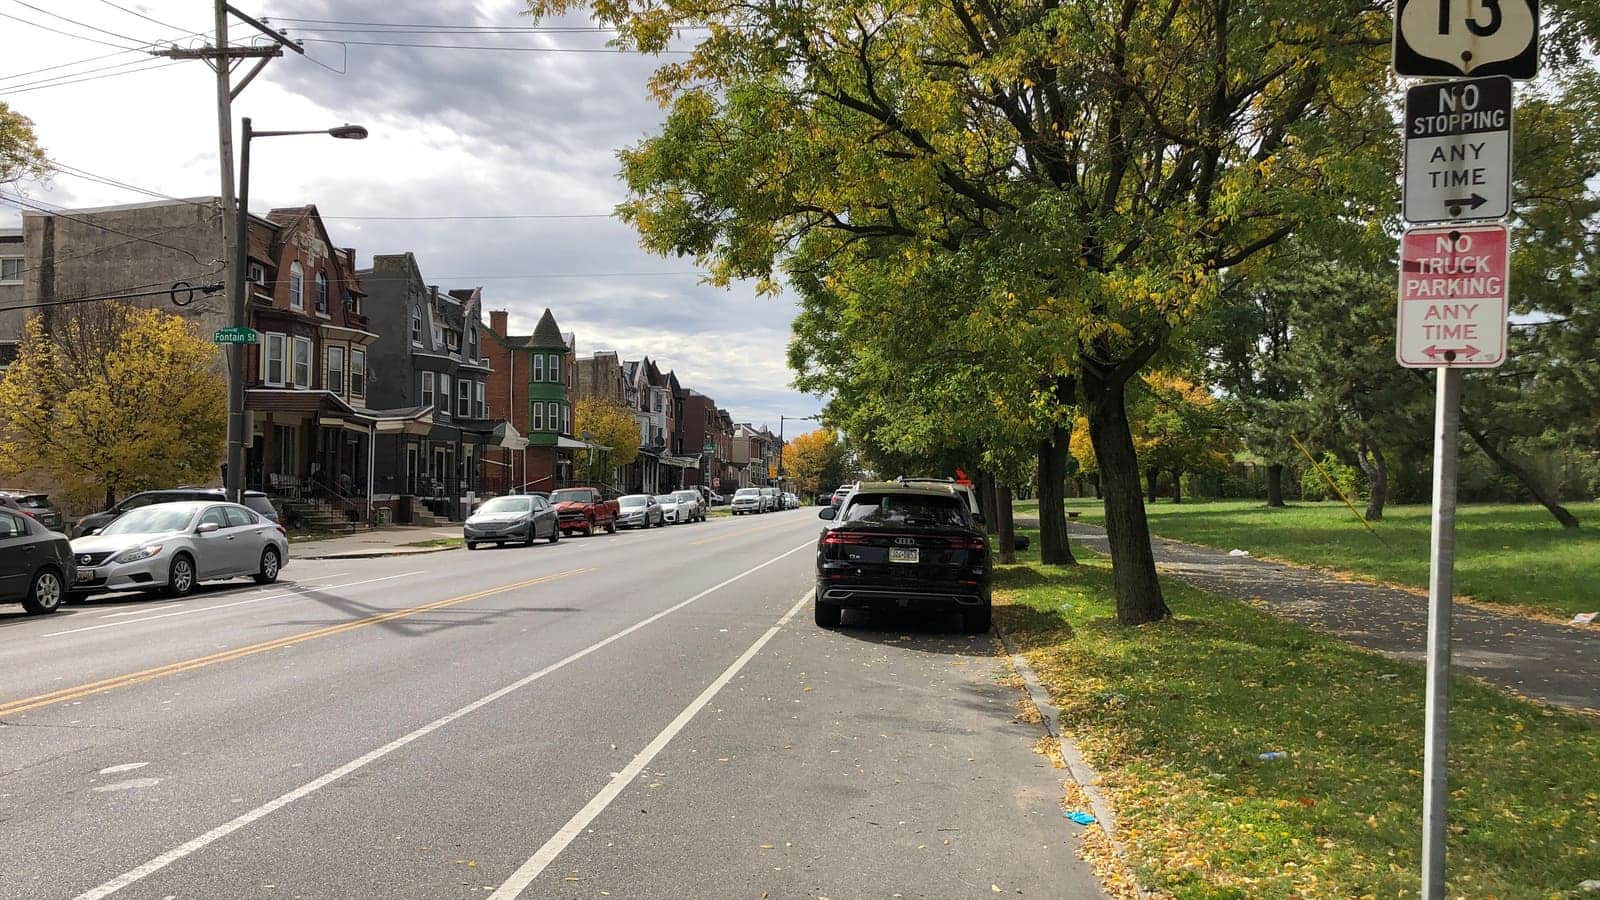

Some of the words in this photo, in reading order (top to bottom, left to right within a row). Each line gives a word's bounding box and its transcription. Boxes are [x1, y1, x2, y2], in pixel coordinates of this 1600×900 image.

[1438, 84, 1480, 112] NO
[1414, 109, 1505, 135] STOPPING
[1430, 142, 1486, 163] ANY
[1428, 168, 1486, 188] TIME
[1436, 235, 1472, 254] NO
[1416, 255, 1490, 275] TRUCK
[1406, 276, 1501, 297] PARKING
[1424, 303, 1479, 321] ANY
[215, 332, 245, 342] Fontain
[247, 333, 255, 342] St
[1422, 324, 1478, 340] TIME
